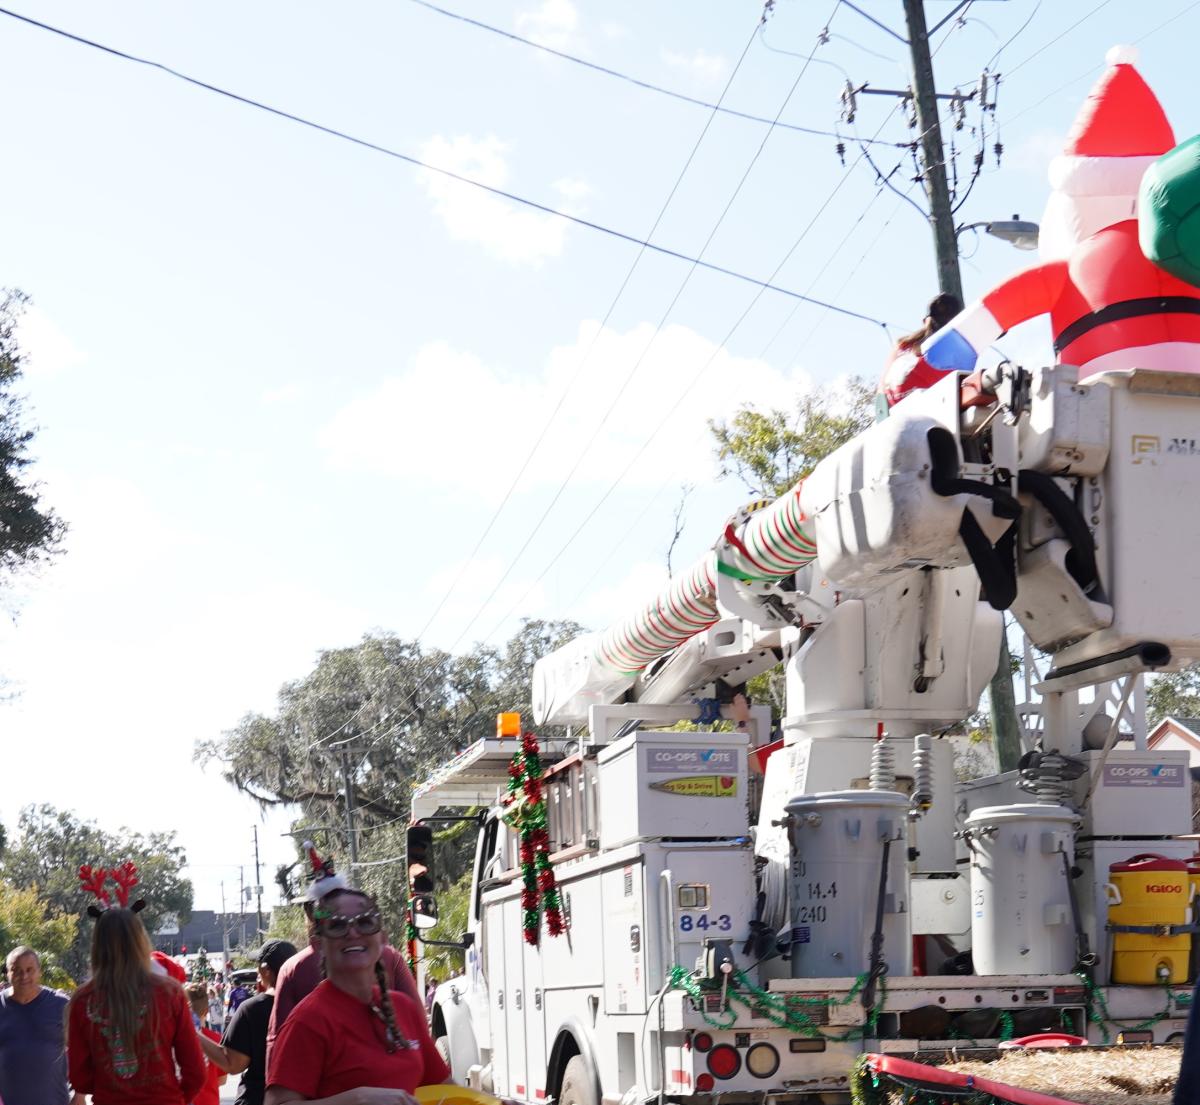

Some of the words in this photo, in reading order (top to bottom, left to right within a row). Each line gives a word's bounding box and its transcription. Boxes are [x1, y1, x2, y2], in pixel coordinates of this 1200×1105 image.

[655, 752, 697, 762] CO-OPS
[1110, 767, 1149, 777] CO-OPS
[807, 881, 837, 899] 14.4
[1146, 884, 1182, 894] IGLOO
[680, 914, 732, 932] 84-3
